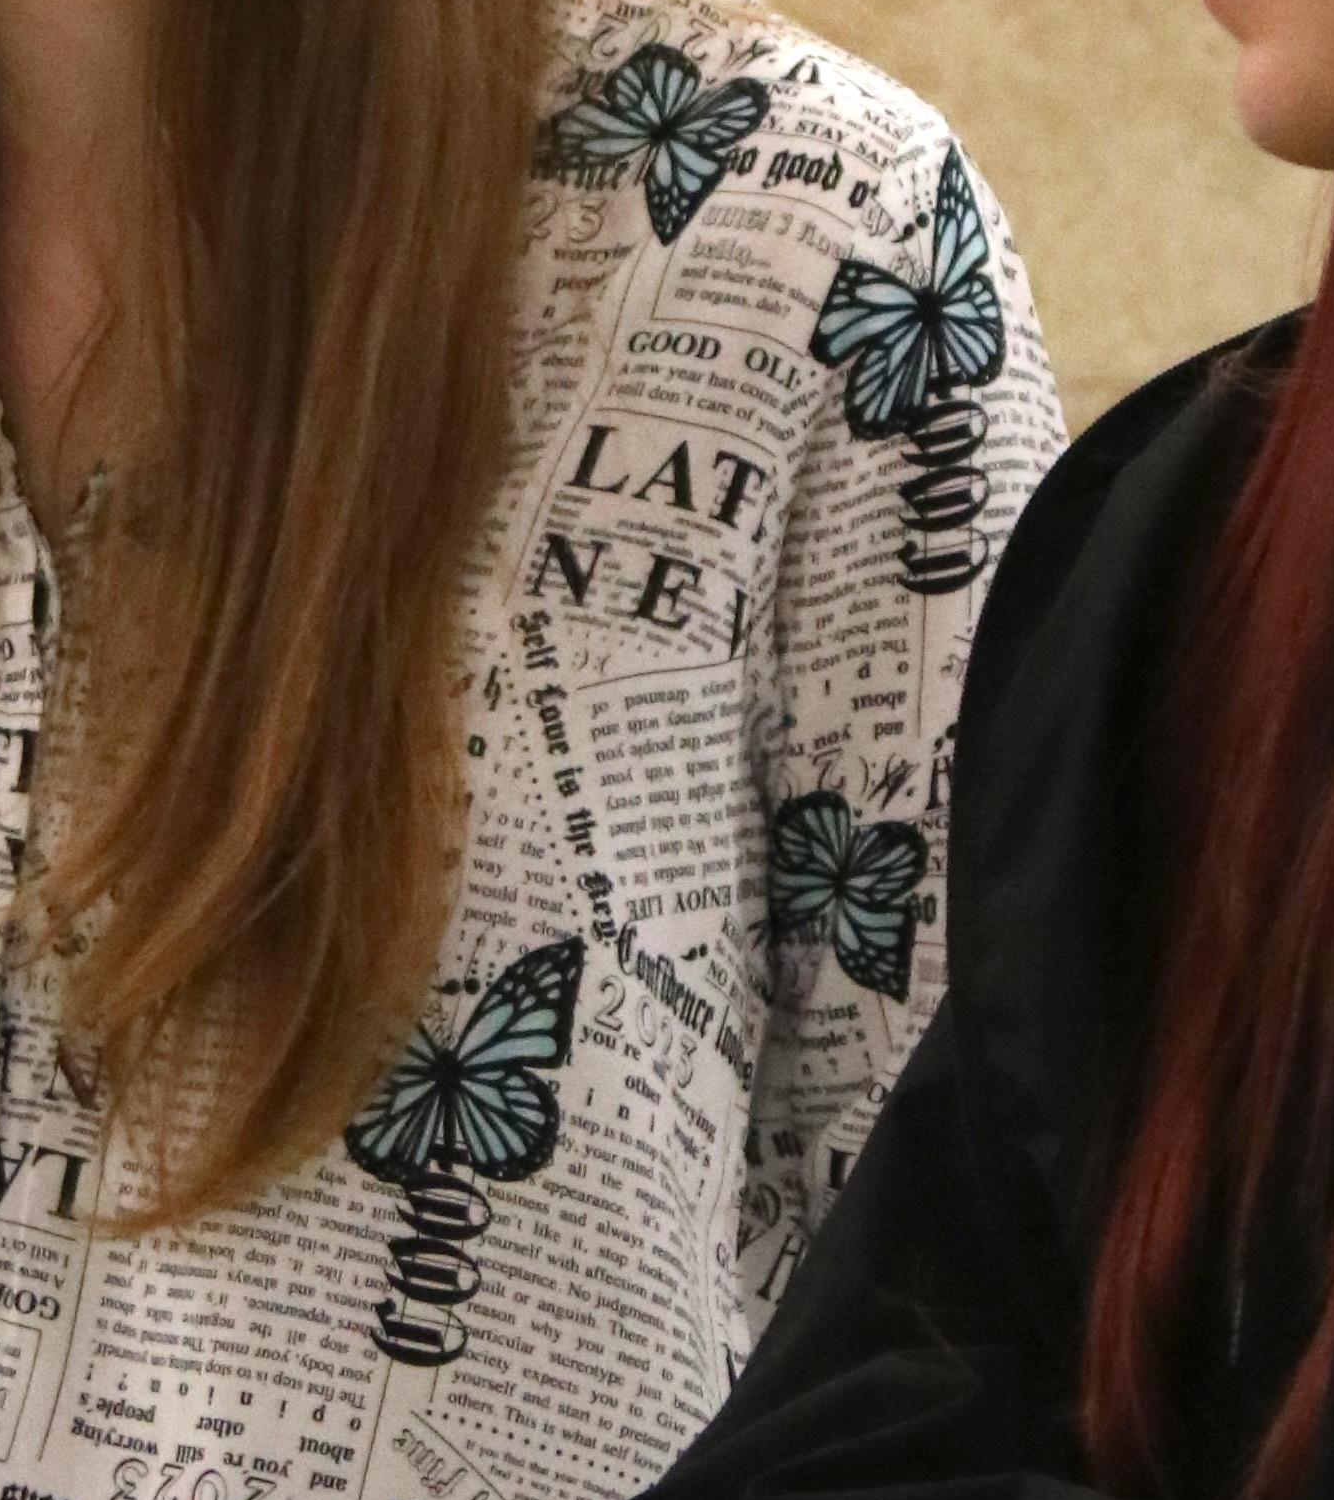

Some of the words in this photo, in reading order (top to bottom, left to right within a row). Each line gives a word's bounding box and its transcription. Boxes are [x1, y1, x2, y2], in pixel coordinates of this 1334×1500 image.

[762, 150, 843, 191] good
[628, 330, 722, 360] GOOD
[668, 365, 703, 384] year
[709, 374, 737, 391] has
[698, 395, 732, 417] care
[736, 406, 755, 423] of
[874, 615, 909, 631] your
[624, 688, 689, 709] dreamed
[852, 690, 907, 711] about
[527, 684, 569, 754] Love
[590, 721, 620, 741] and
[874, 721, 904, 740] and
[554, 765, 584, 797] is
[565, 808, 596, 856] the
[473, 859, 505, 877] way
[525, 869, 554, 887] you
[626, 896, 662, 921] LIFE
[674, 885, 732, 914] ENJOY
[461, 907, 518, 928] people
[620, 1131, 633, 1144] to
[585, 1142, 618, 1163] your
[568, 1161, 587, 1178] all
[601, 1172, 623, 1190] the
[543, 1178, 630, 1219] appearance,
[286, 1211, 309, 1228] No
[487, 1184, 550, 1214] business
[560, 1208, 587, 1227] and
[596, 1220, 645, 1248] always
[297, 1236, 329, 1253] with
[533, 1221, 561, 1242] like
[573, 1236, 587, 1253] it,
[598, 1245, 629, 1267] stop
[245, 1248, 277, 1266] stop
[479, 1233, 543, 1259] yourself
[547, 1252, 580, 1274] with
[585, 1264, 647, 1298] affection
[227, 1270, 279, 1290] always
[315, 1263, 343, 1283] like
[288, 1282, 316, 1298] and
[568, 1280, 591, 1301] No
[248, 1321, 273, 1338] the
[514, 1291, 530, 1304] or
[609, 1318, 649, 1347] There
[656, 1342, 666, 1354] is
[287, 1330, 307, 1345] all
[319, 1337, 349, 1354] stop
[467, 1301, 516, 1325] reason
[531, 1319, 562, 1343] why
[577, 1336, 605, 1355] you
[618, 1351, 650, 1372] need
[662, 1368, 673, 1381] to
[255, 1348, 289, 1363] your
[205, 1361, 234, 1378] stop
[237, 1367, 253, 1379] to
[256, 1370, 268, 1382] is
[338, 1366, 373, 1384] your
[549, 1351, 625, 1387] stereotype
[636, 1382, 662, 1401] just
[273, 1371, 303, 1390] step
[307, 1382, 335, 1402] first
[338, 1386, 366, 1410] The
[522, 1366, 580, 1395] expects
[590, 1389, 619, 1407] you
[656, 1411, 687, 1436] Give
[79, 1391, 157, 1424] people's
[452, 1369, 516, 1396] yourself
[522, 1392, 550, 1409] and
[558, 1404, 590, 1422] start
[598, 1416, 612, 1431] to
[619, 1424, 671, 1452] pretend
[71, 1416, 158, 1456] worrying
[195, 1416, 245, 1438] other
[299, 1435, 355, 1464] about
[505, 1405, 538, 1430] This
[543, 1419, 555, 1435] is
[562, 1428, 598, 1450] what
[602, 1442, 630, 1460] self
[633, 1451, 662, 1474] love
[176, 1444, 205, 1463] still
[310, 1472, 347, 1490] and
